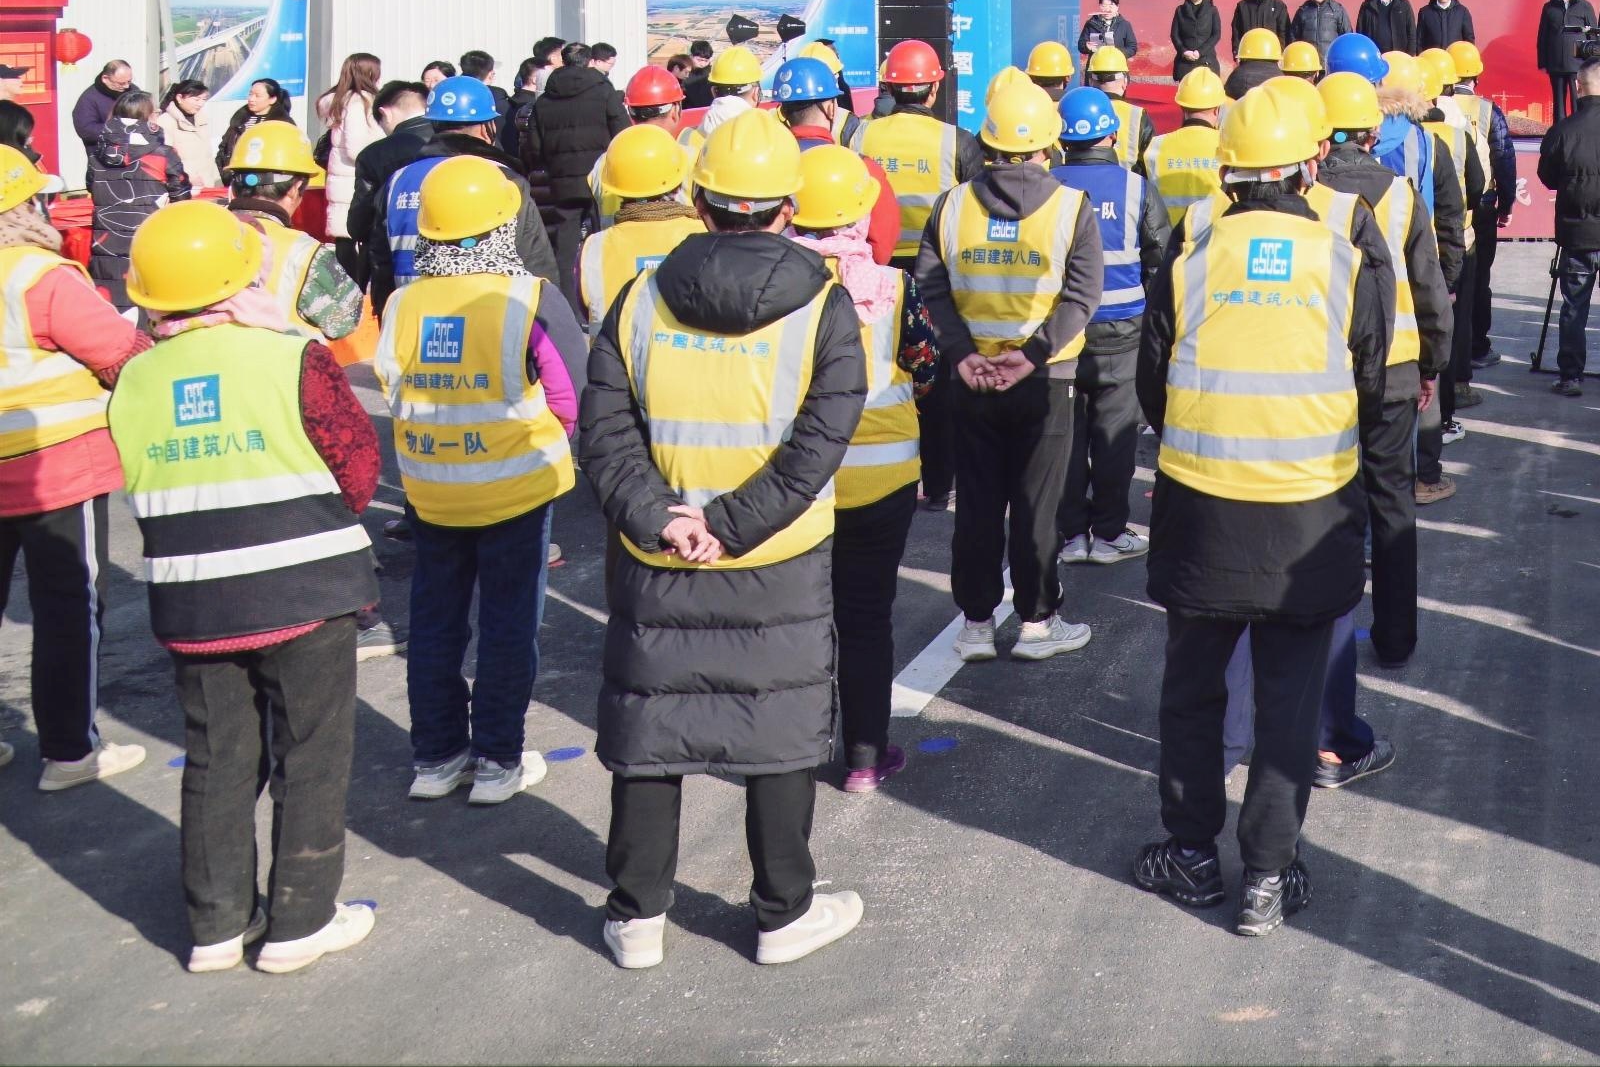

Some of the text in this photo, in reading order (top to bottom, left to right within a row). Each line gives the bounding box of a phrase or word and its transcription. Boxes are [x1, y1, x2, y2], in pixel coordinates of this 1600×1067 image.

[960, 247, 1041, 267] 中国建筑八局
[404, 373, 489, 390] 中国建筑八局
[146, 428, 267, 464] 中国建筑八局
